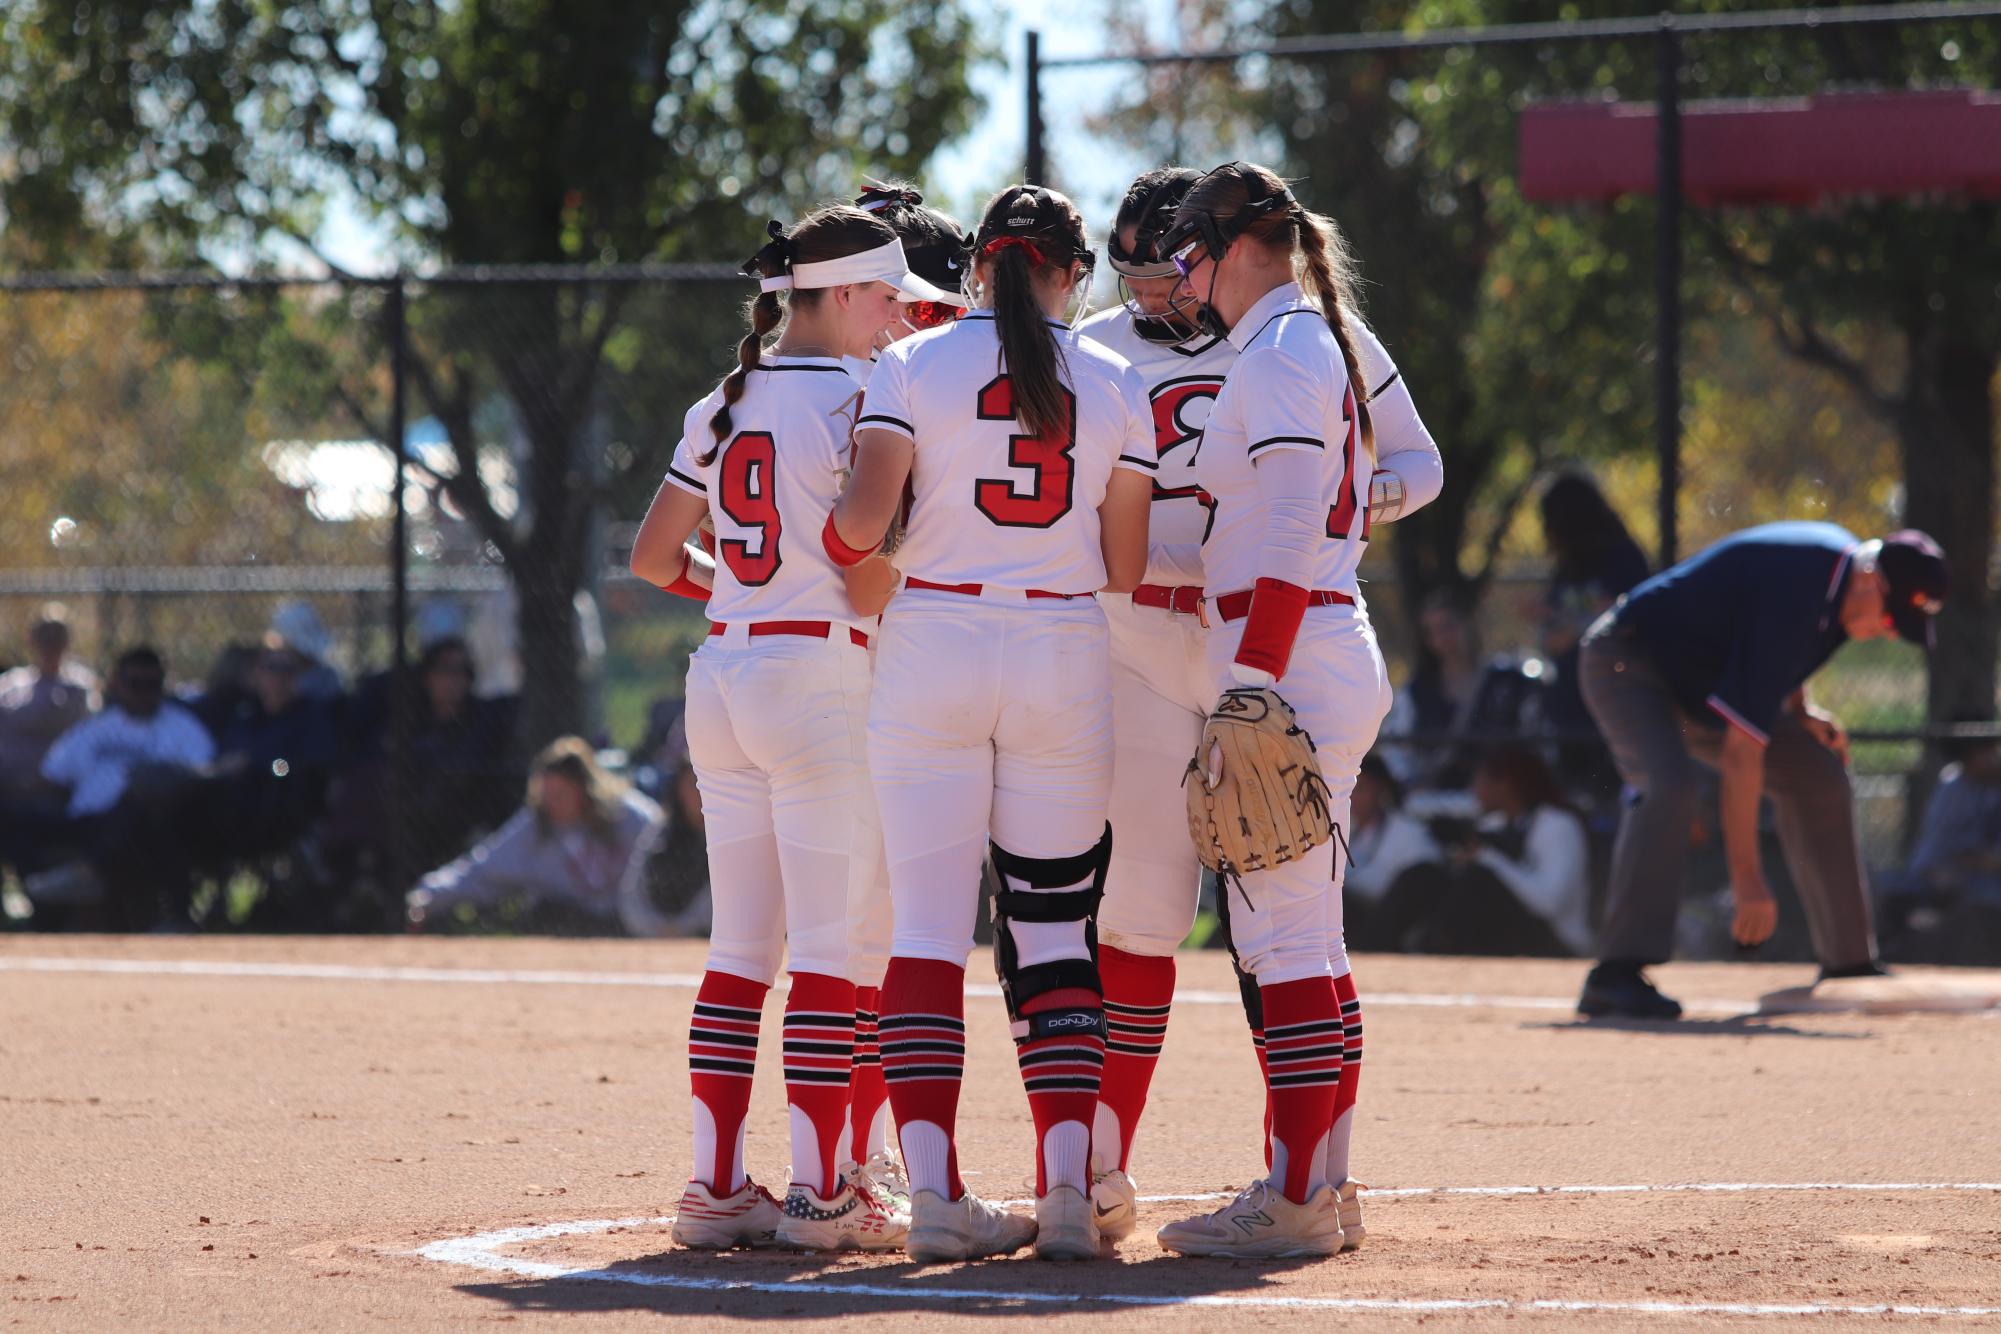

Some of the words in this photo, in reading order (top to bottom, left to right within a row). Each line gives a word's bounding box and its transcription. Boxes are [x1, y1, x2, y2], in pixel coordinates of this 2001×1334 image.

[1007, 216, 1035, 225] schutt
[719, 431, 783, 587] 9
[974, 373, 1077, 528] 3
